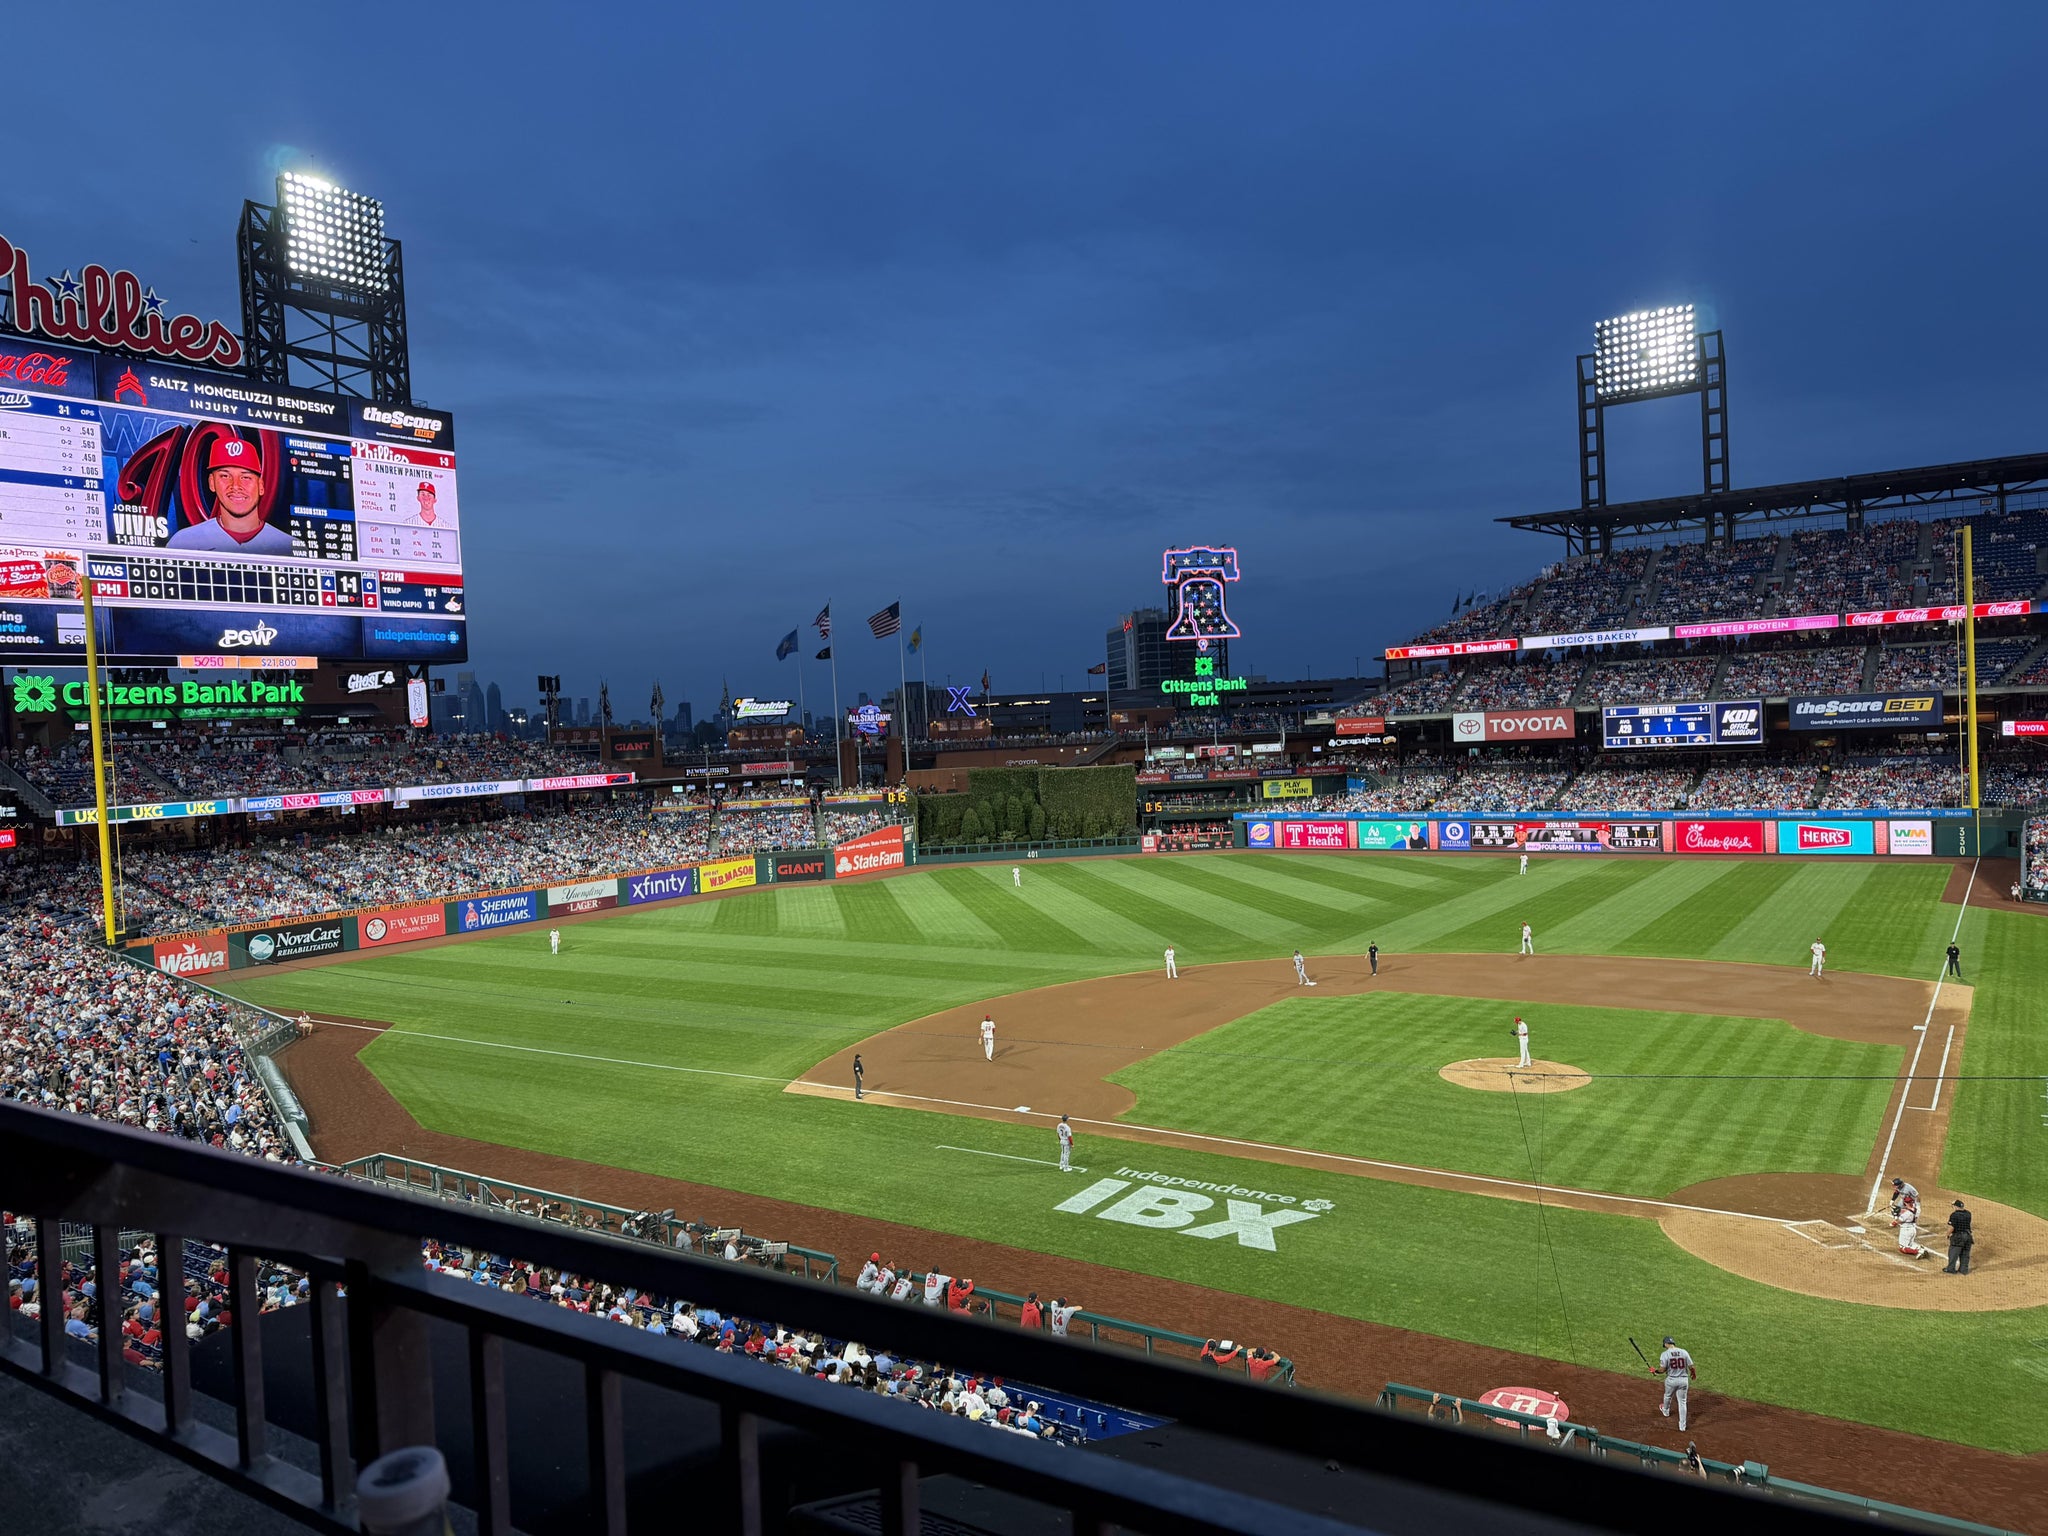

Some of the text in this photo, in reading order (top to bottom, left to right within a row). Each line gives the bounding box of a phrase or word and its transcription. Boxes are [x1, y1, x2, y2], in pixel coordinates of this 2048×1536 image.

[150, 376, 335, 415] SALTZ MONGELUZZI BENDESKY
[59, 405, 70, 415] 3-1
[190, 399, 304, 424] INJURY LAWYERS
[363, 406, 442, 431] theScore
[351, 440, 449, 466] Phillies 1-3
[375, 464, 403, 476] ANDREW
[405, 468, 433, 480] PAINTER
[113, 504, 149, 514] JORBIT
[113, 513, 169, 538] VIVAS
[9, 564, 37, 572] TASTE
[91, 564, 373, 590] WAS 0 0 0 0 3 0 4 0
[340, 576, 357, 593] 1-1
[382, 586, 401, 594] TEMP
[97, 584, 375, 605] PHI 0 0 1 1 2 0 4 2
[384, 599, 402, 608] WIND
[1988, 602, 2023, 616] Coca-Cola
[1896, 608, 1929, 621] Coca-Cola
[1680, 626, 1708, 635] WHEY
[1710, 624, 1744, 633] BETTER
[1748, 620, 1788, 631] PROTEIN
[224, 629, 271, 646] PGW
[374, 628, 447, 644] Independence
[1552, 631, 1638, 645] LISCIO'S BAKERY
[1408, 641, 1510, 657] Phillies win Deals roll in
[261, 657, 297, 667] $21,800
[348, 671, 385, 691] GHOST
[1161, 676, 1247, 693] Citizens Bank
[182, 681, 247, 704] Bank
[252, 680, 305, 703] Park
[1190, 692, 1219, 706] Park
[1795, 699, 1930, 715] theScore BET
[848, 713, 892, 722] ALL STAR GAME
[1722, 709, 1758, 723] KDI
[1489, 716, 1568, 733] TOYOTA
[1721, 727, 1759, 736] TECHNOLOGY
[1729, 722, 1749, 730] OFFICE
[2016, 724, 2045, 733] TOYOTA
[615, 742, 650, 752] GIANT
[545, 775, 608, 789] RAV4th INNING
[1284, 781, 1301, 789] PLAY
[354, 790, 383, 802] NECA
[422, 783, 499, 797] LISCIO'S BAKERY
[1293, 786, 1309, 795] WIN!
[186, 801, 217, 815] UKG
[286, 796, 317, 808] NECA
[132, 806, 164, 819] UKG
[1306, 824, 1344, 836] Temple
[1802, 830, 1846, 843] HERR'S
[1894, 828, 1927, 838] WM
[1307, 835, 1343, 847] Health
[1027, 850, 1039, 859] 401
[777, 862, 824, 875] GIANT
[486, 886, 525, 897] ASPLUNDH
[561, 884, 605, 902] Yuengling
[632, 873, 687, 899] xfinity
[389, 899, 432, 911] ASPLUNDH
[439, 892, 480, 904] ASPLUNDH
[480, 896, 528, 913] SHERWIN
[336, 905, 381, 918] ASPLUNDH
[570, 899, 598, 912] LAGER
[279, 913, 327, 927] ASPLUNDH
[390, 913, 440, 930] F.W. WEBB
[480, 910, 531, 927] WILLIAMS.
[218, 921, 270, 935] ASPLUNDH
[401, 925, 428, 935] COMPANY
[153, 930, 209, 944] ASPLUNDH
[275, 928, 341, 949] NovaCare
[277, 940, 339, 957] REHABILITATION
[159, 951, 225, 974] Wawa
[1113, 1166, 1297, 1204] Independence
[1052, 1177, 1322, 1252] IBX
[926, 1276, 937, 1288] 29
[1669, 1357, 1686, 1370] 20
